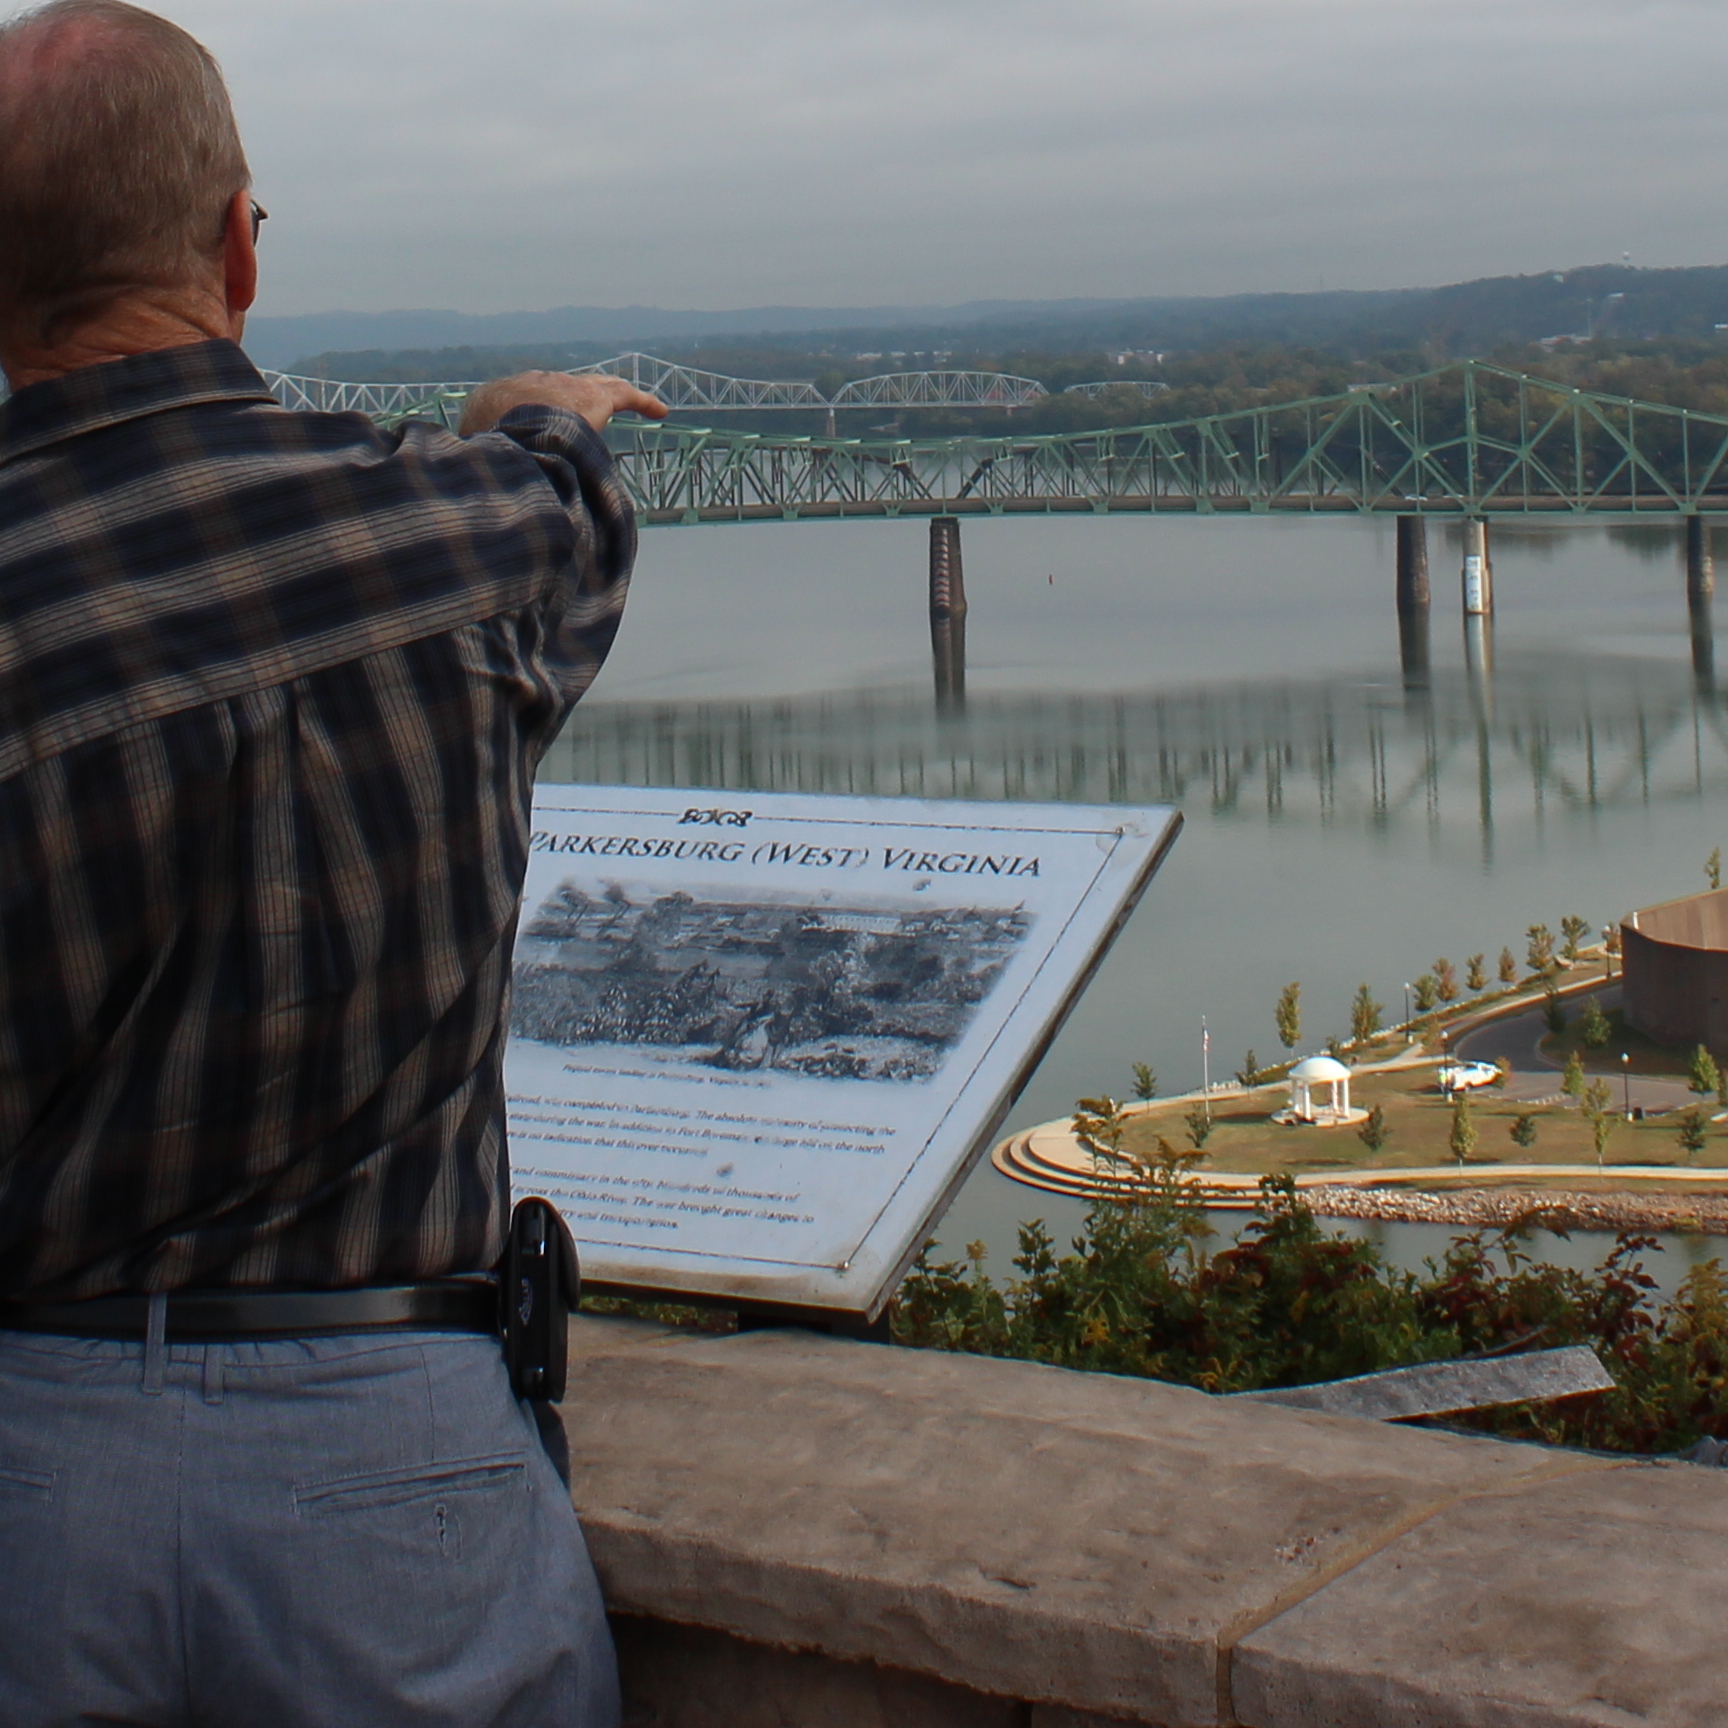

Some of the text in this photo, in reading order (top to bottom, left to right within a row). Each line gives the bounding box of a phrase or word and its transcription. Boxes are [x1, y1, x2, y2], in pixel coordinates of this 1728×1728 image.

[528, 831, 1041, 877] PARKERSBURG (WEST) VIRGINIA
[563, 1100, 617, 1111] completed
[696, 1109, 714, 1120] The
[715, 1112, 758, 1124] absolute
[543, 1133, 593, 1146] indication
[594, 1136, 616, 1147] that
[616, 1138, 635, 1149] this
[636, 1143, 660, 1152] ever
[568, 1116, 585, 1126] the
[835, 1141, 853, 1151] the
[854, 1144, 885, 1154] north
[513, 1166, 535, 1176] and
[535, 1168, 598, 1183] commissary
[599, 1173, 610, 1183] in
[612, 1175, 630, 1186] the
[633, 1195, 653, 1207] The
[678, 1199, 722, 1215] brought
[722, 1206, 752, 1218] great
[754, 1209, 800, 1224] changes
